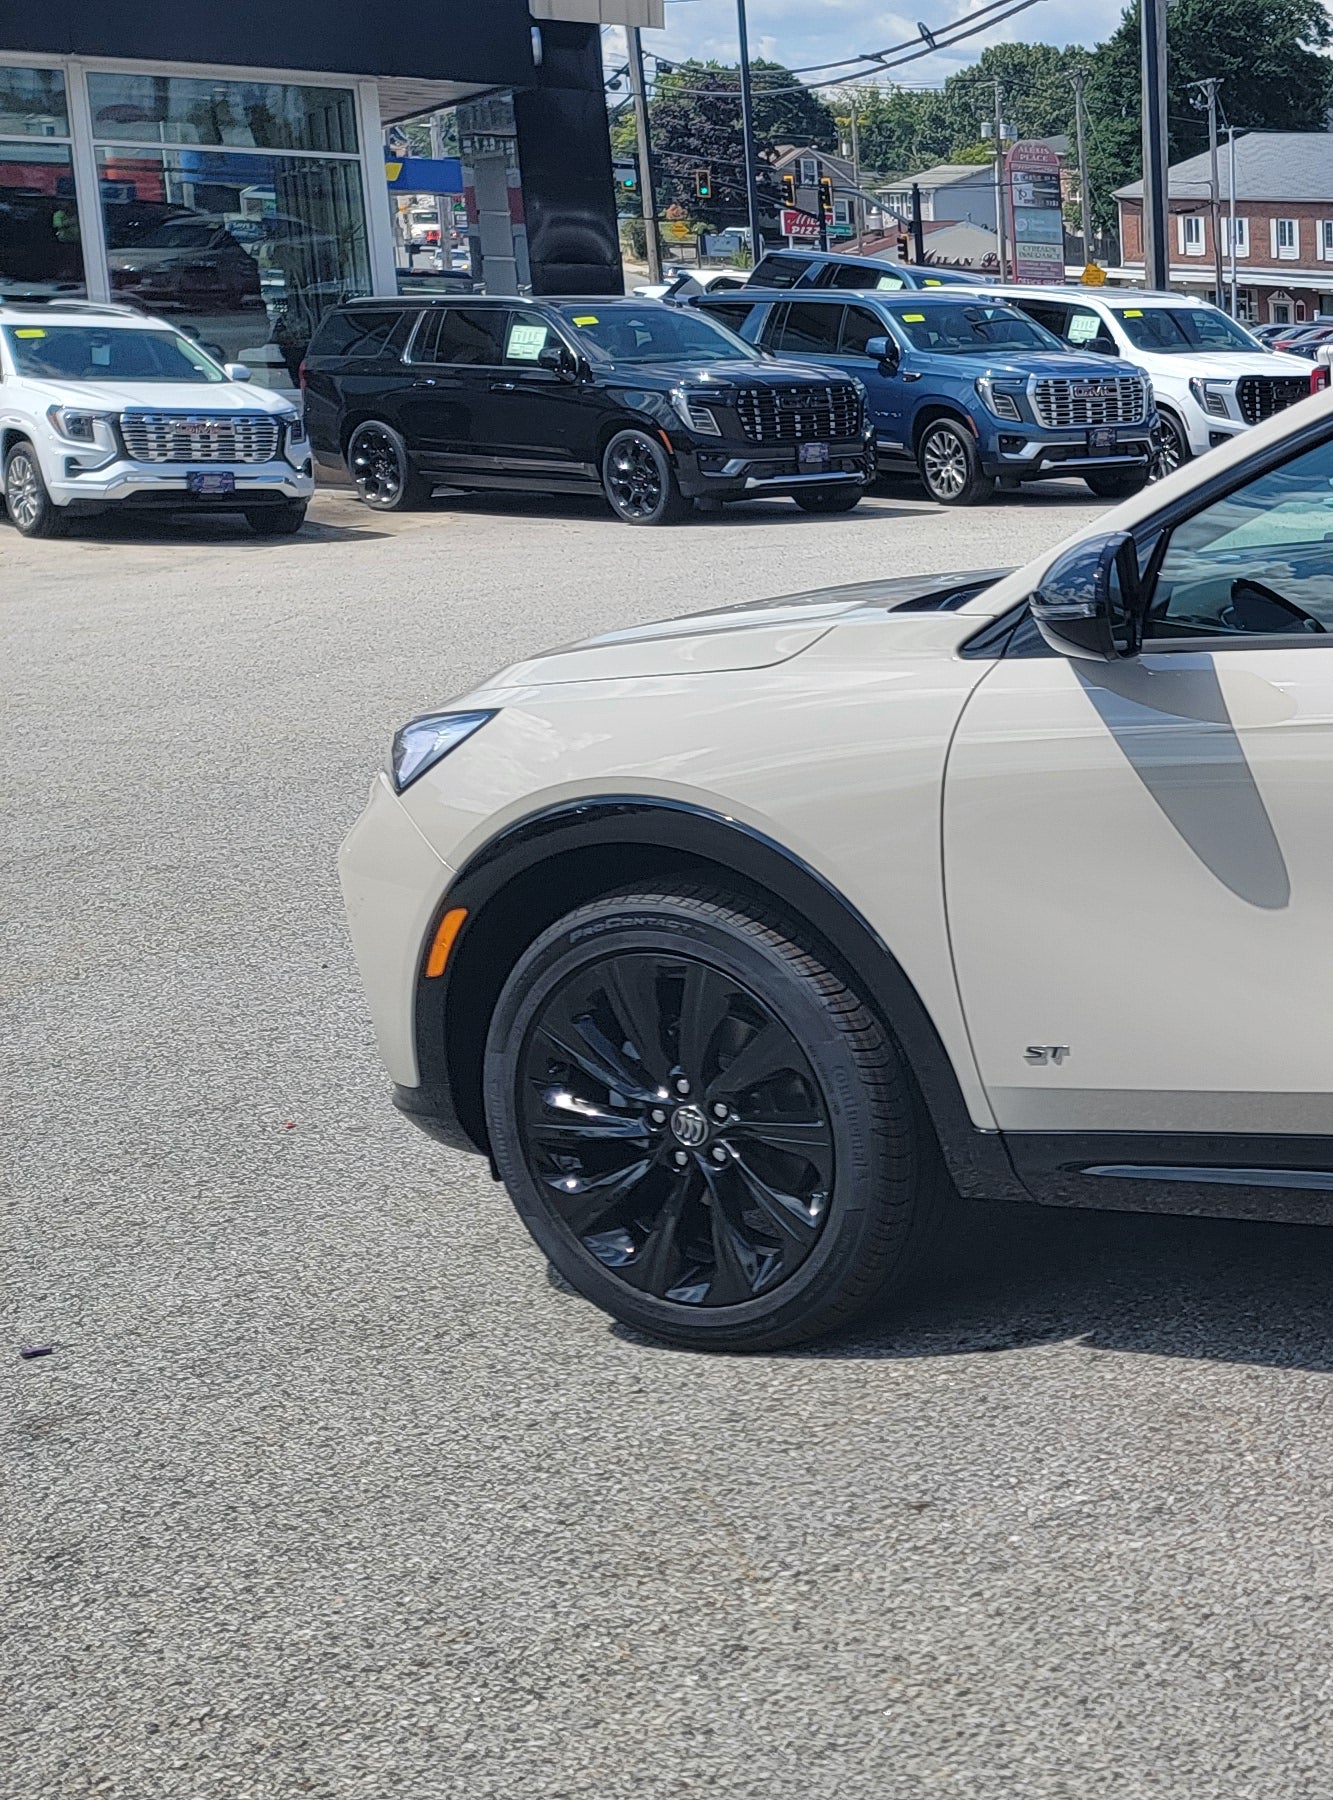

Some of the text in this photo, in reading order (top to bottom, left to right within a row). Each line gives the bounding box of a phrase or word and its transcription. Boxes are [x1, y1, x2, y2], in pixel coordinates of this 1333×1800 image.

[1019, 153, 1049, 161] PLACE
[791, 225, 820, 235] PIZZ
[1022, 1045, 1070, 1063] ST
